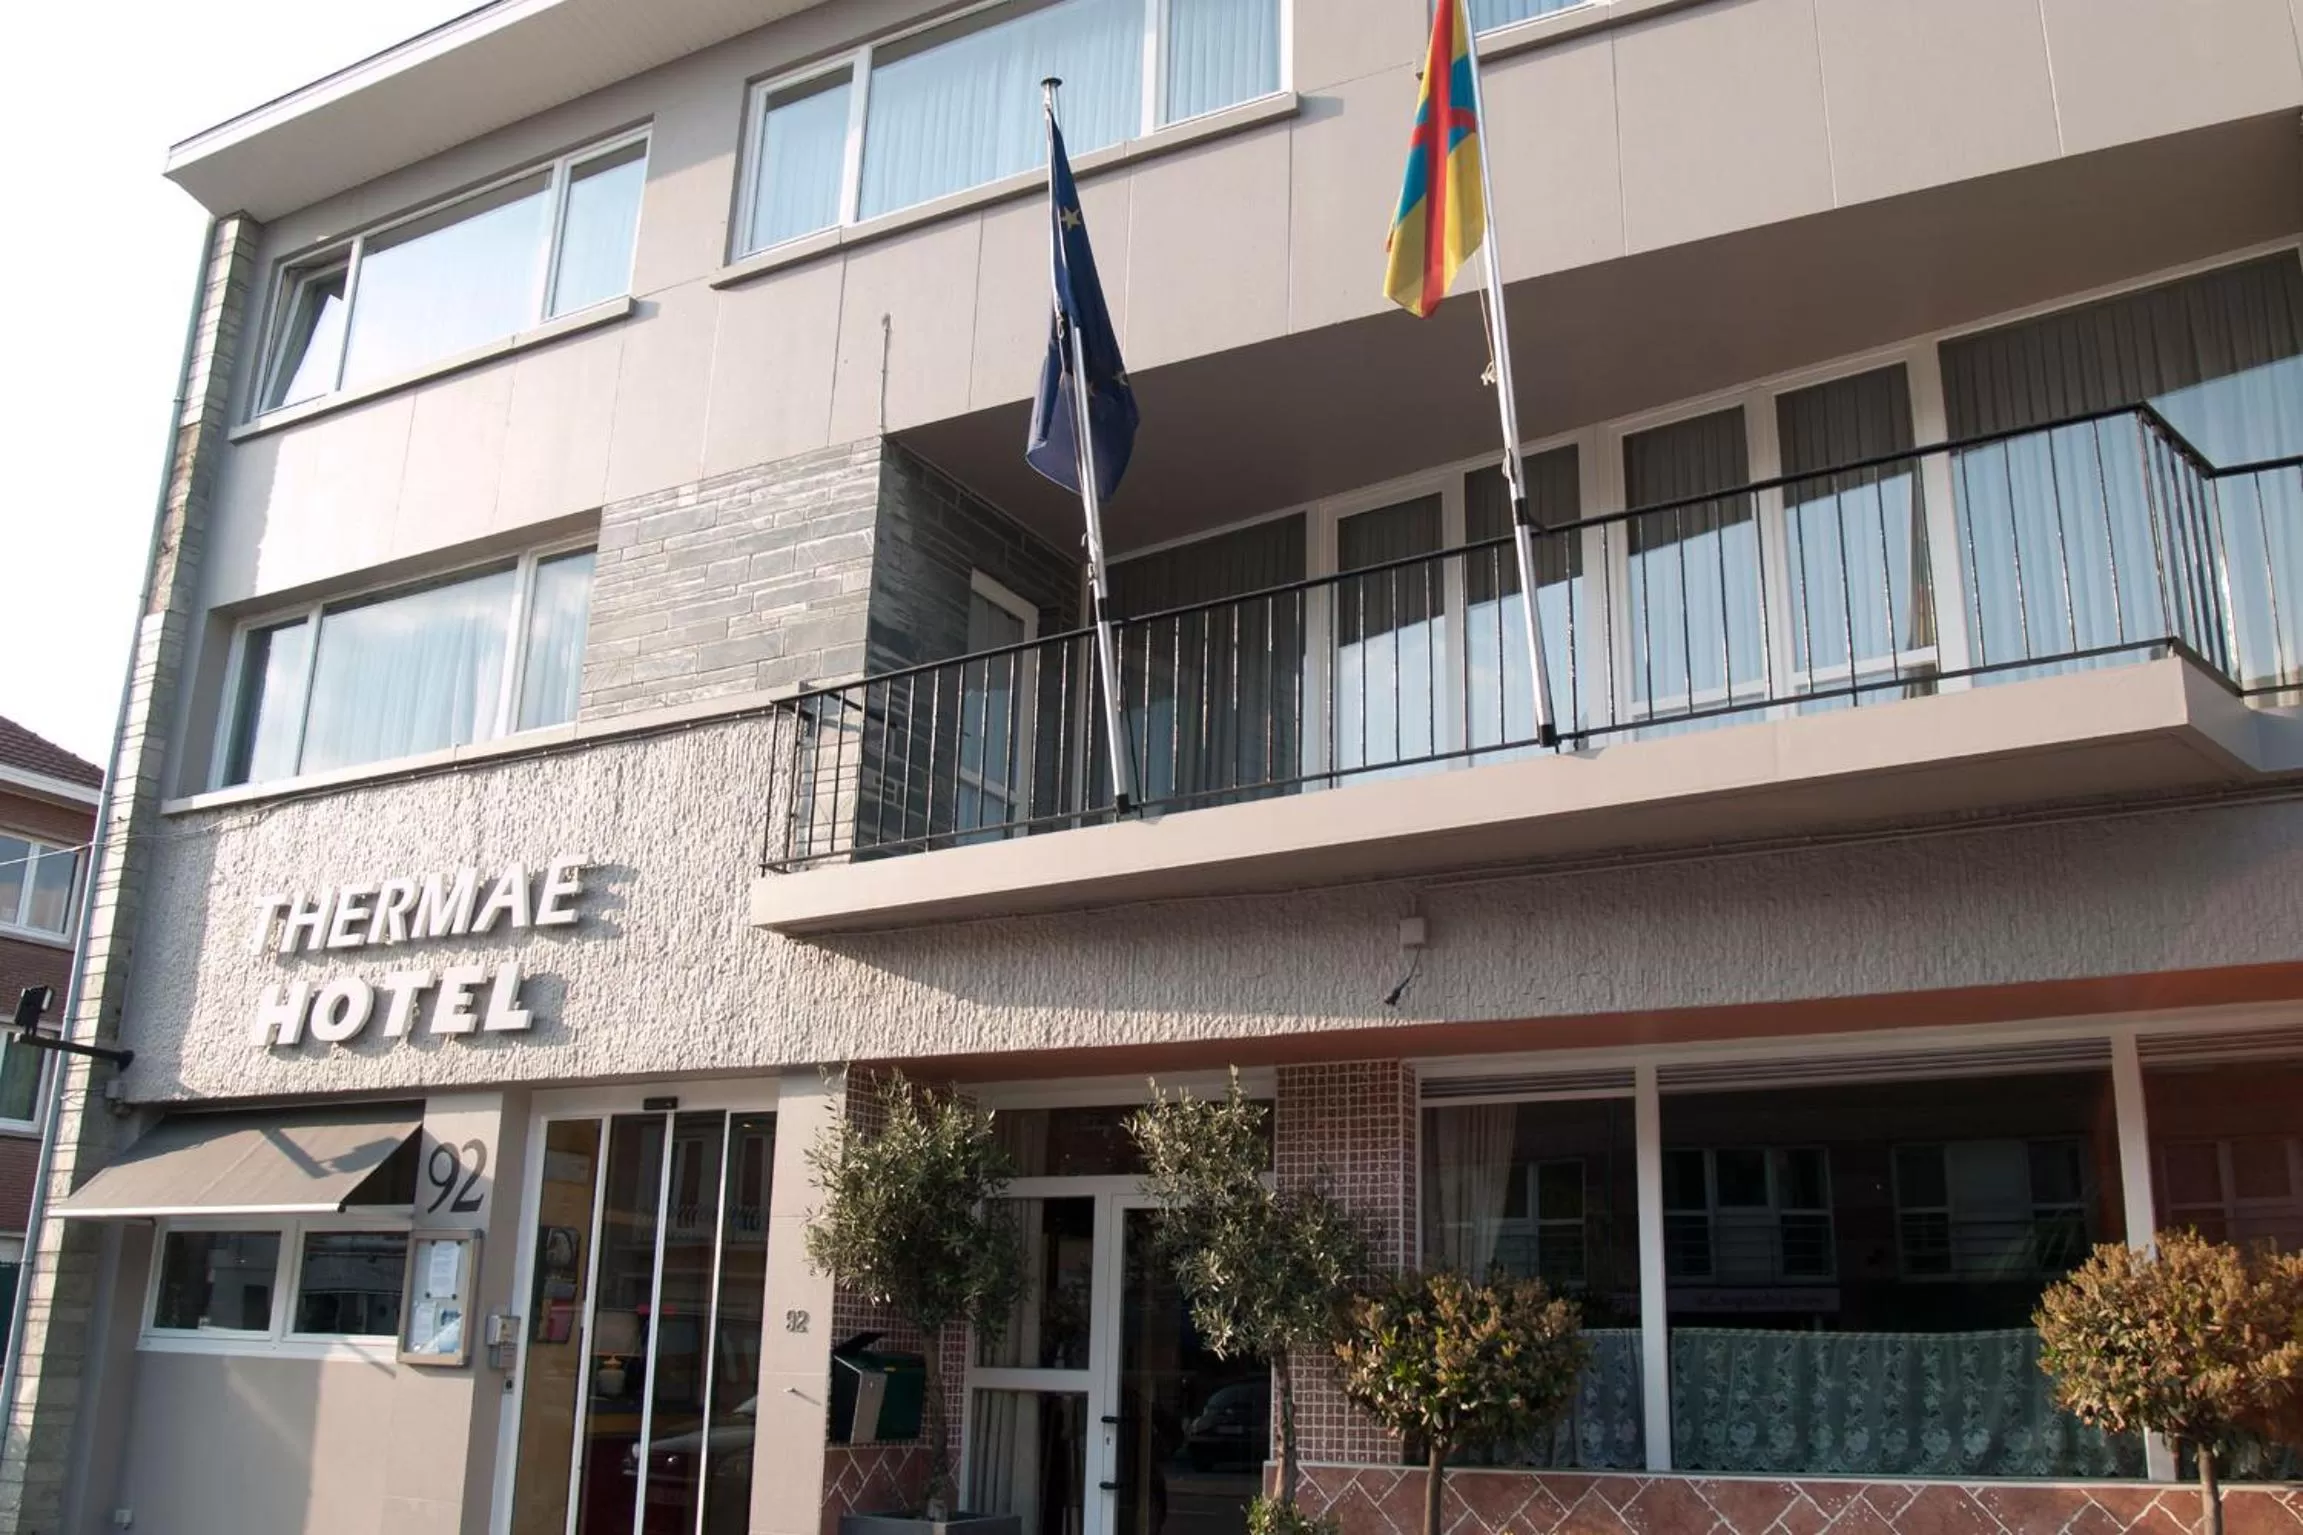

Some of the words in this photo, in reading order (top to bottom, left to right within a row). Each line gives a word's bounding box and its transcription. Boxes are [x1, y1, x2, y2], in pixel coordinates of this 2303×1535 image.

[251, 855, 595, 957] THERMAE
[255, 962, 534, 1047] HOTEL
[427, 1138, 488, 1214] 92
[786, 1310, 810, 1334] 92
